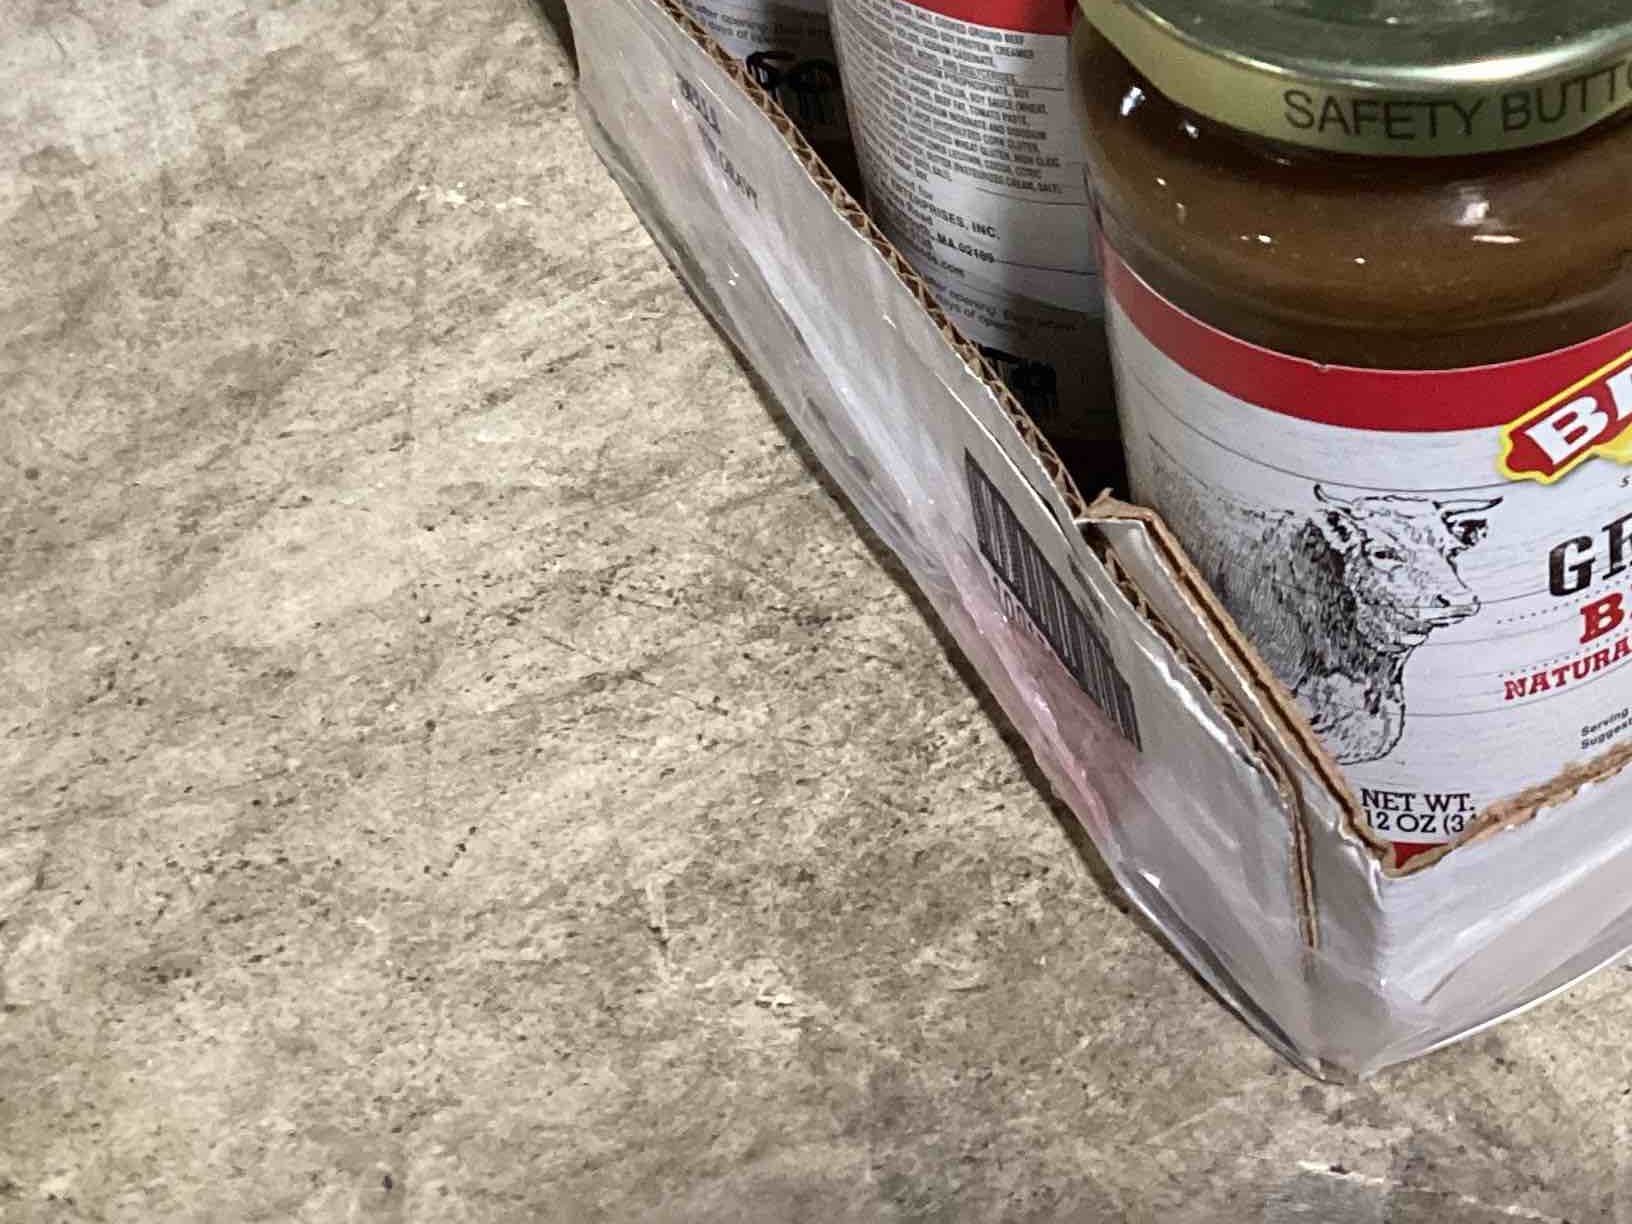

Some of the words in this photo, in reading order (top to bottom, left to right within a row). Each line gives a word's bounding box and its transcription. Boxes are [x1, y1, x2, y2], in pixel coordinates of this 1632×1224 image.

[1283, 89, 1488, 141] SAFETY
[1580, 706, 1630, 736] Serving
[1361, 788, 1414, 813] NET
[1422, 790, 1476, 814] WT.
[1365, 811, 1392, 833] 12
[1396, 812, 1438, 834] OZ
